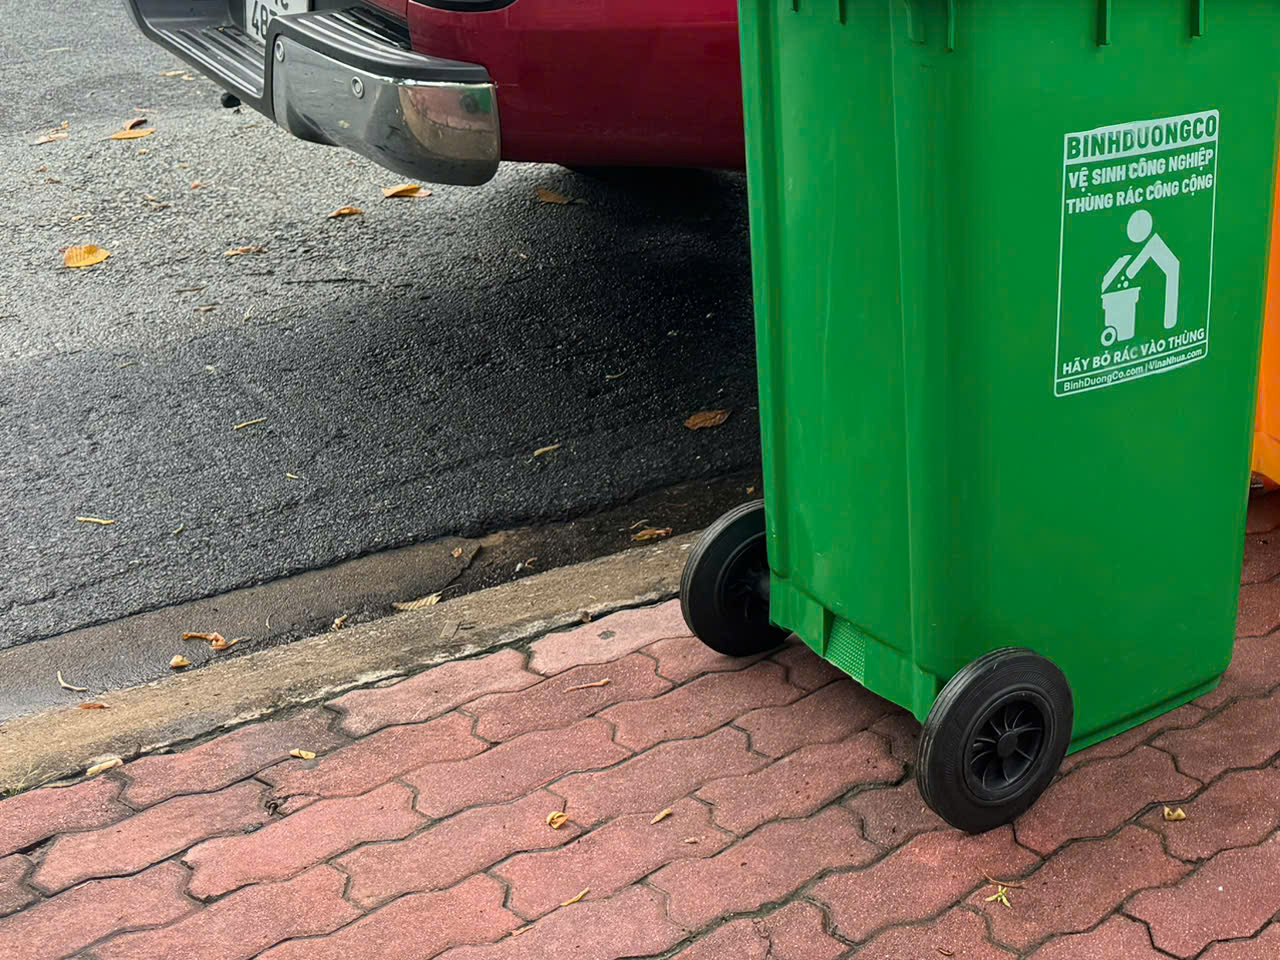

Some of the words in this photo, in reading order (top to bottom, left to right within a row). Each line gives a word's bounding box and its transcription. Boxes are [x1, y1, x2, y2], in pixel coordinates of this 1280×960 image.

[1067, 115, 1217, 160] BINHDUONGCO
[1069, 167, 1089, 192] VỆ
[1092, 165, 1126, 185] SINH
[1128, 158, 1166, 179] CÔNG
[1168, 147, 1214, 172] NGHIỆP
[1066, 193, 1113, 214] THÙNG
[1116, 186, 1143, 207] RÁC
[1146, 180, 1179, 201] CÔNG
[1182, 173, 1214, 196] CỘNG
[1063, 357, 1090, 375] HÃY
[1093, 350, 1111, 368] BỎ
[1113, 345, 1139, 363] RÁC
[1140, 339, 1166, 355] VÀO
[1168, 328, 1205, 348] THÙNG
[1064, 365, 1144, 392] BinhDuongCo.com
